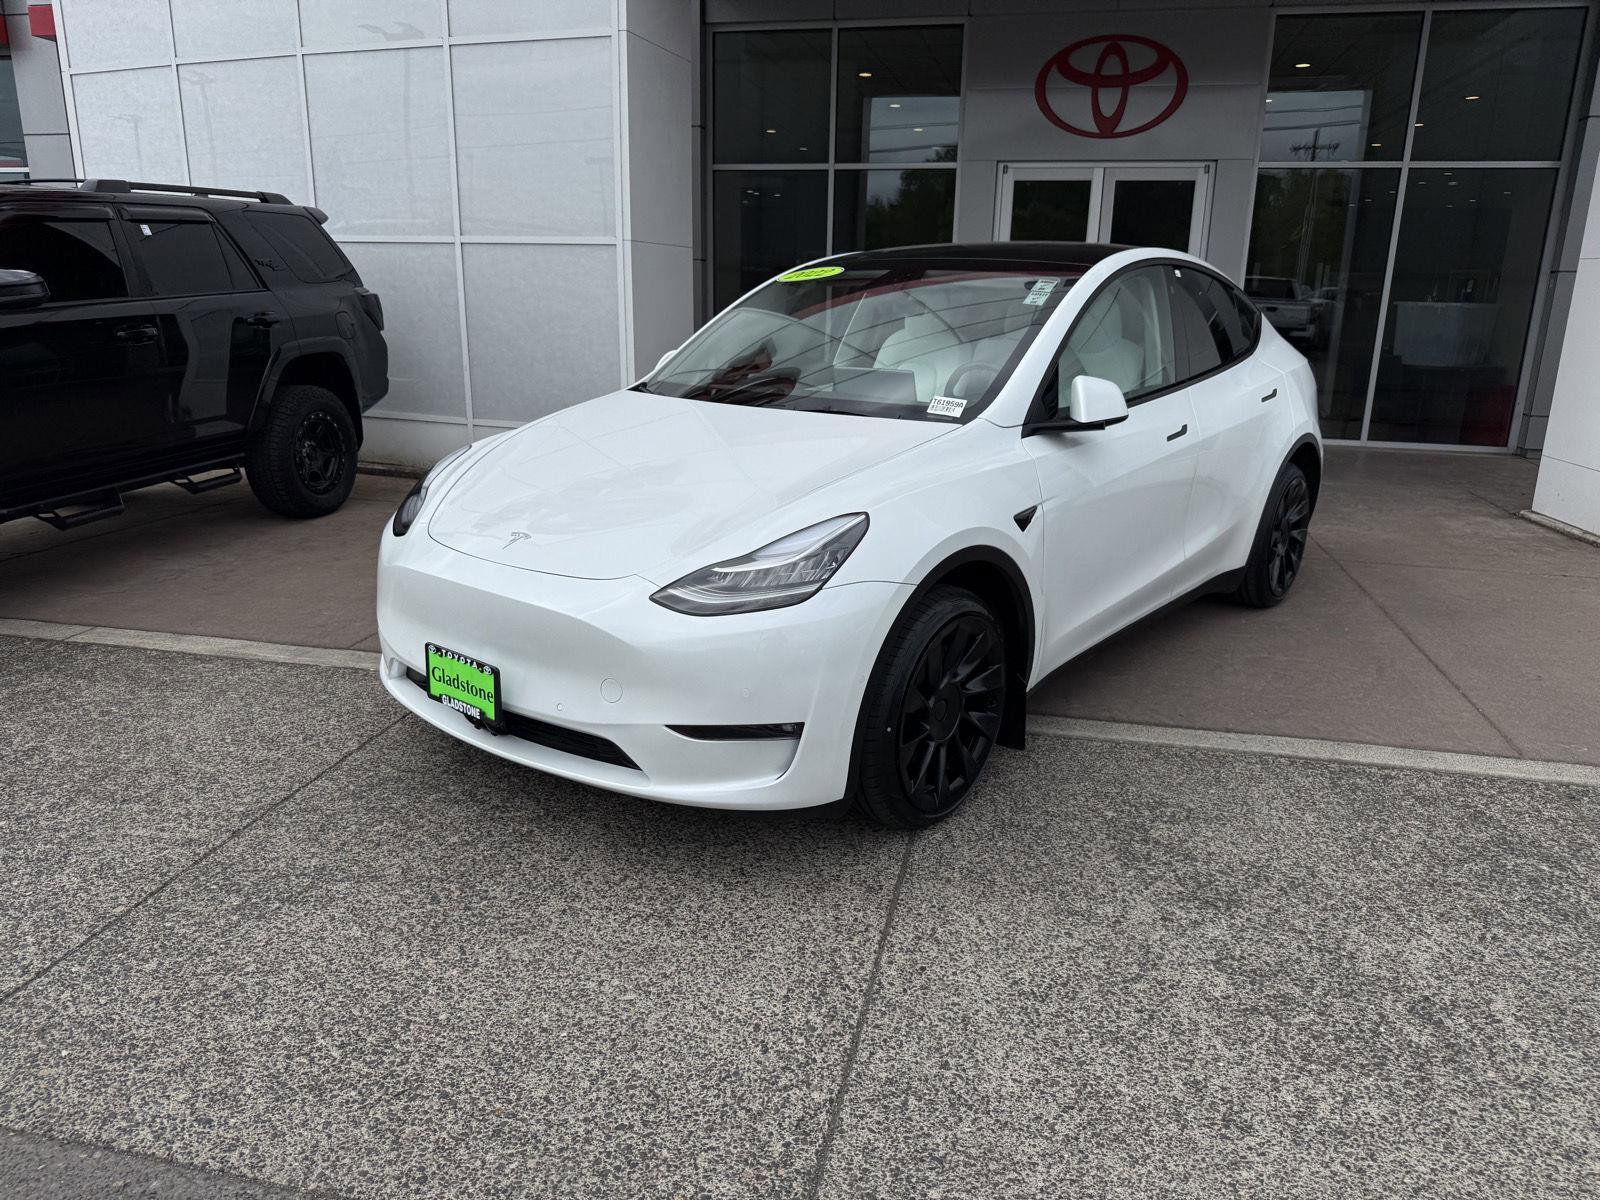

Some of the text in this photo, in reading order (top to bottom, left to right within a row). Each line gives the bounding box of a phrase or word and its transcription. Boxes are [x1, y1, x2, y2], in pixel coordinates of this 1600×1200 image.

[441, 649, 478, 669] TOYOTA
[431, 666, 494, 703] Gladstone
[441, 694, 481, 720] GLADSTONE
